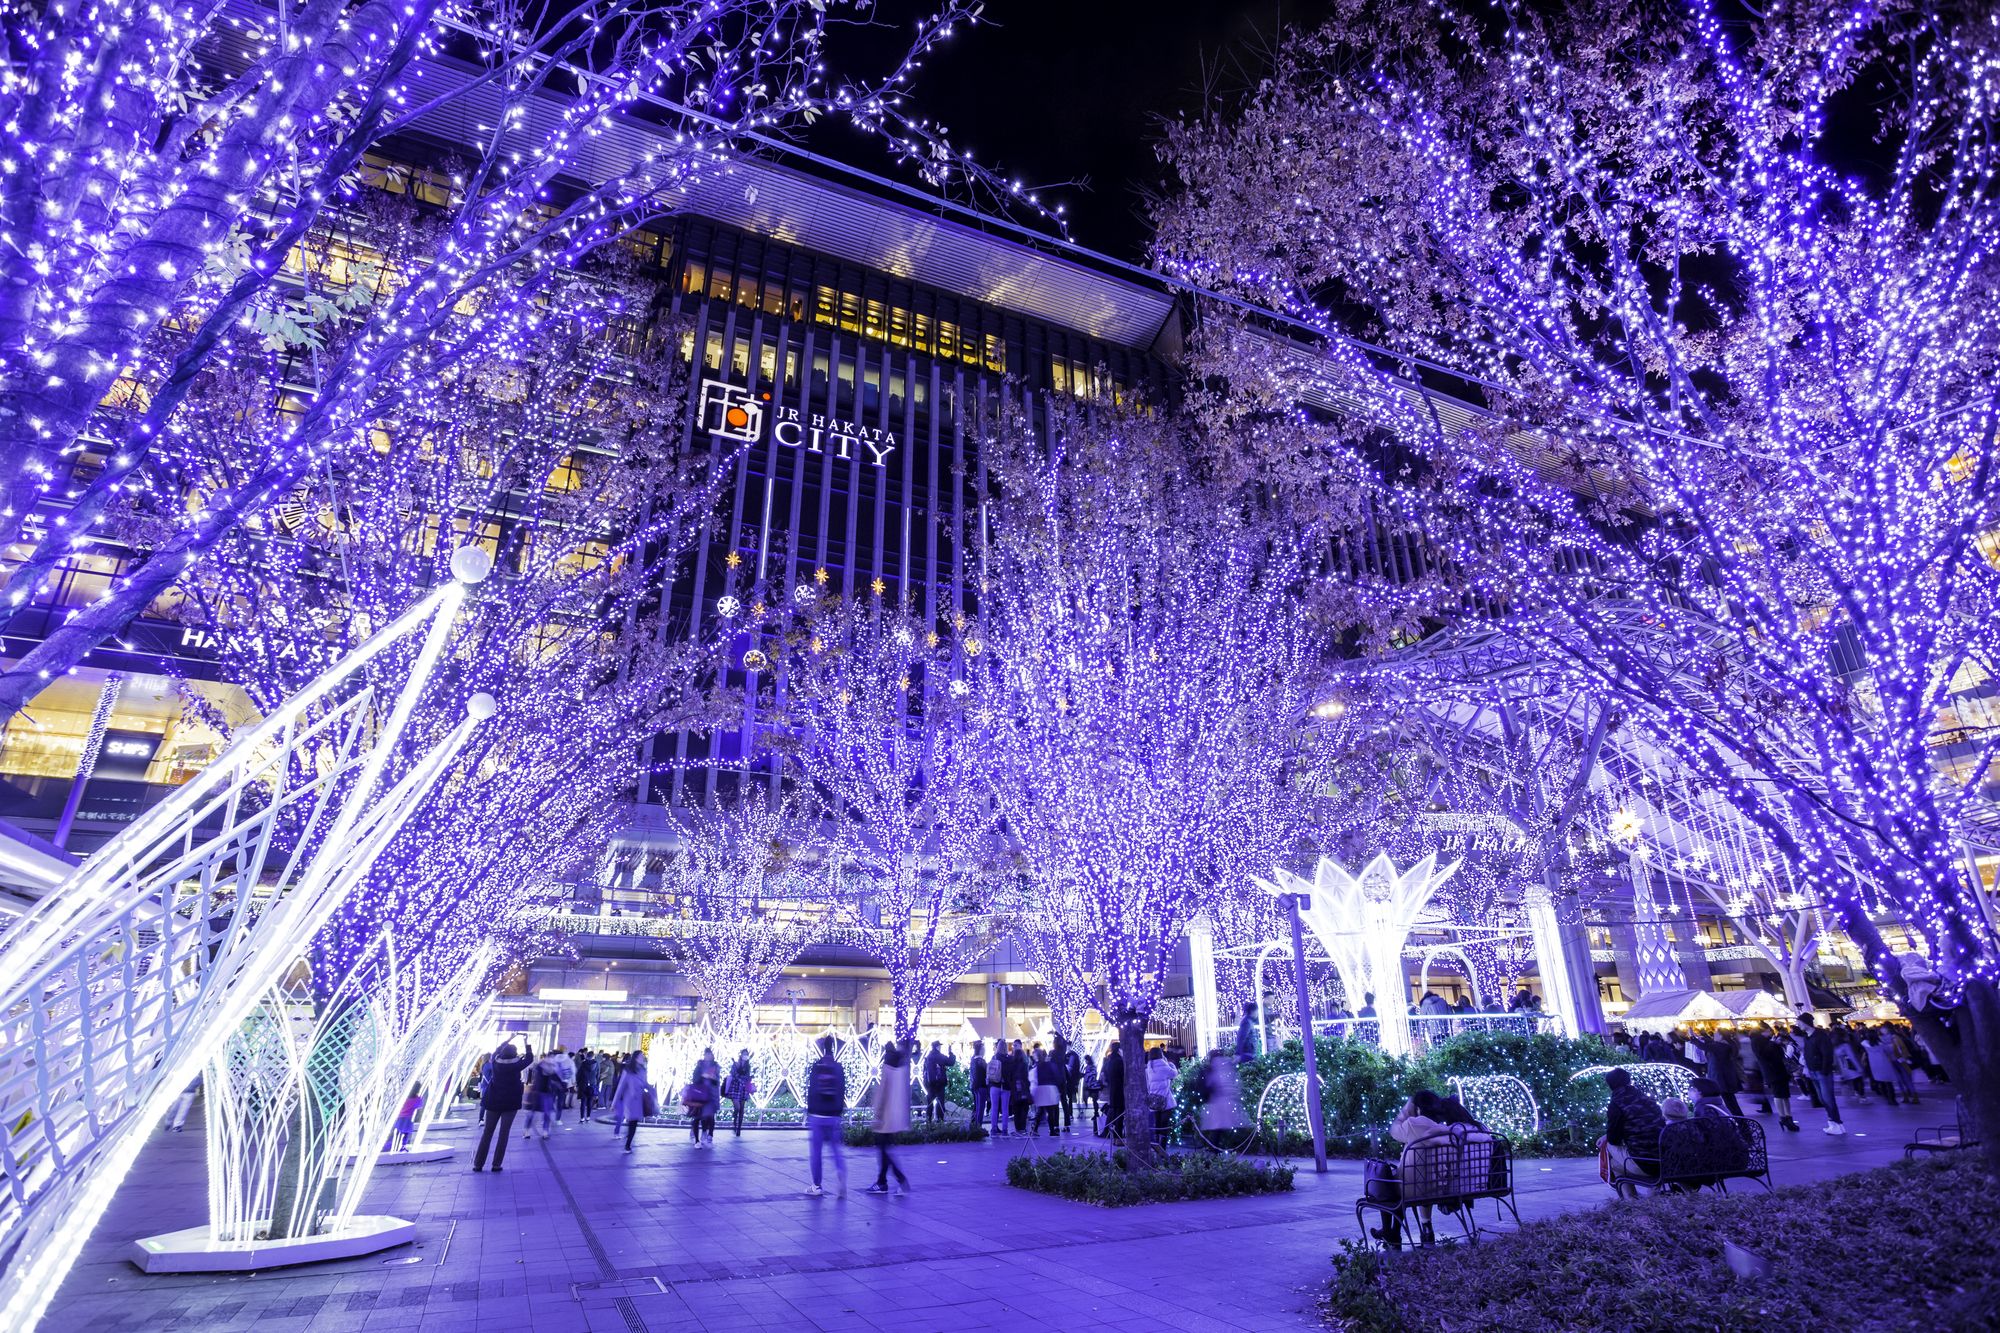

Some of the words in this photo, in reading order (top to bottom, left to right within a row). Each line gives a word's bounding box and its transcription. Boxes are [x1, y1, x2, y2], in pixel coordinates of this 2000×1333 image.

[774, 421, 896, 467] CITY
[776, 406, 799, 422] JR
[812, 413, 896, 445] HAKATA
[108, 741, 150, 756] SHIPS
